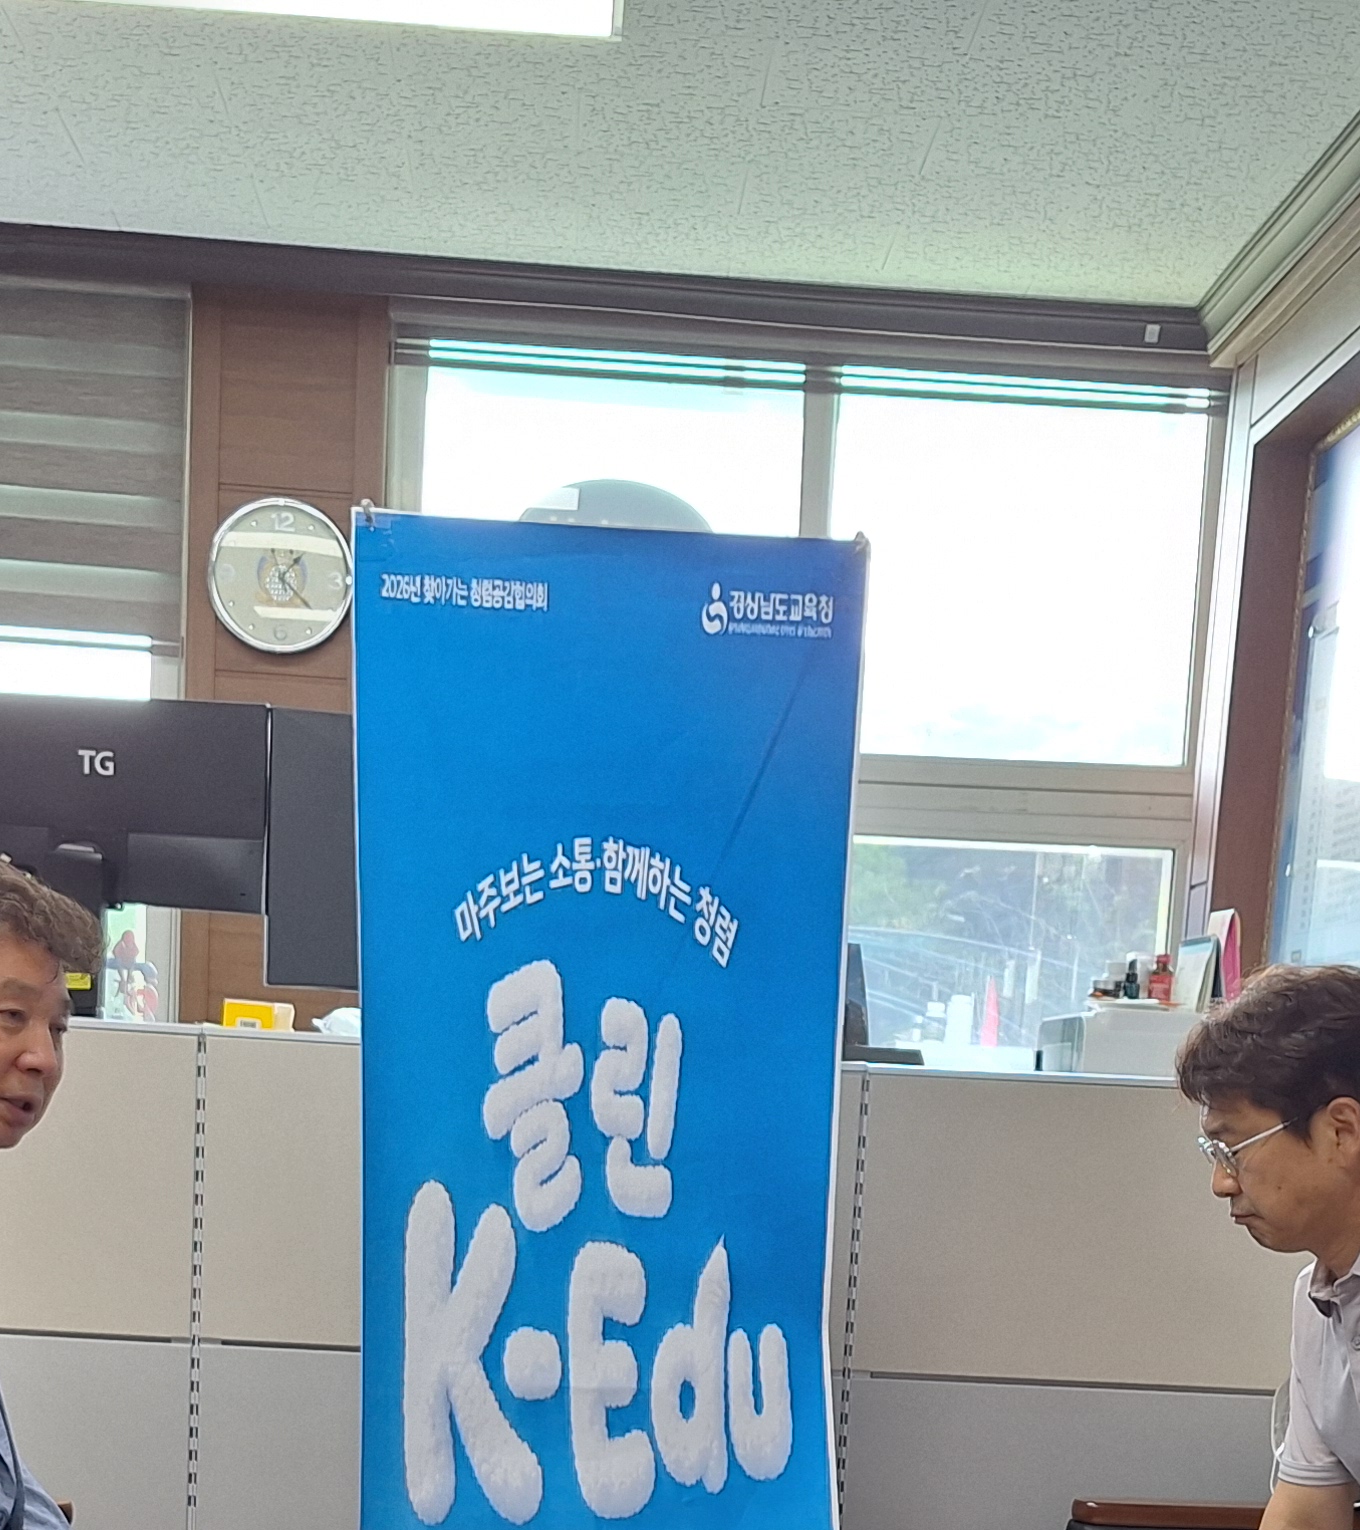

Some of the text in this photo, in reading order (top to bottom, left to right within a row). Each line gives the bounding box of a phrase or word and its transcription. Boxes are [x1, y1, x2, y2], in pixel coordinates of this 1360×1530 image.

[271, 512, 296, 532] 12
[381, 573, 422, 604] 2026년
[423, 575, 469, 606] 찾아가는
[729, 591, 834, 624] 경상남도교육청
[78, 749, 115, 776] TG
[454, 853, 545, 942] 마주보는
[694, 886, 739, 968] 청렴
[484, 960, 683, 1232] 클린
